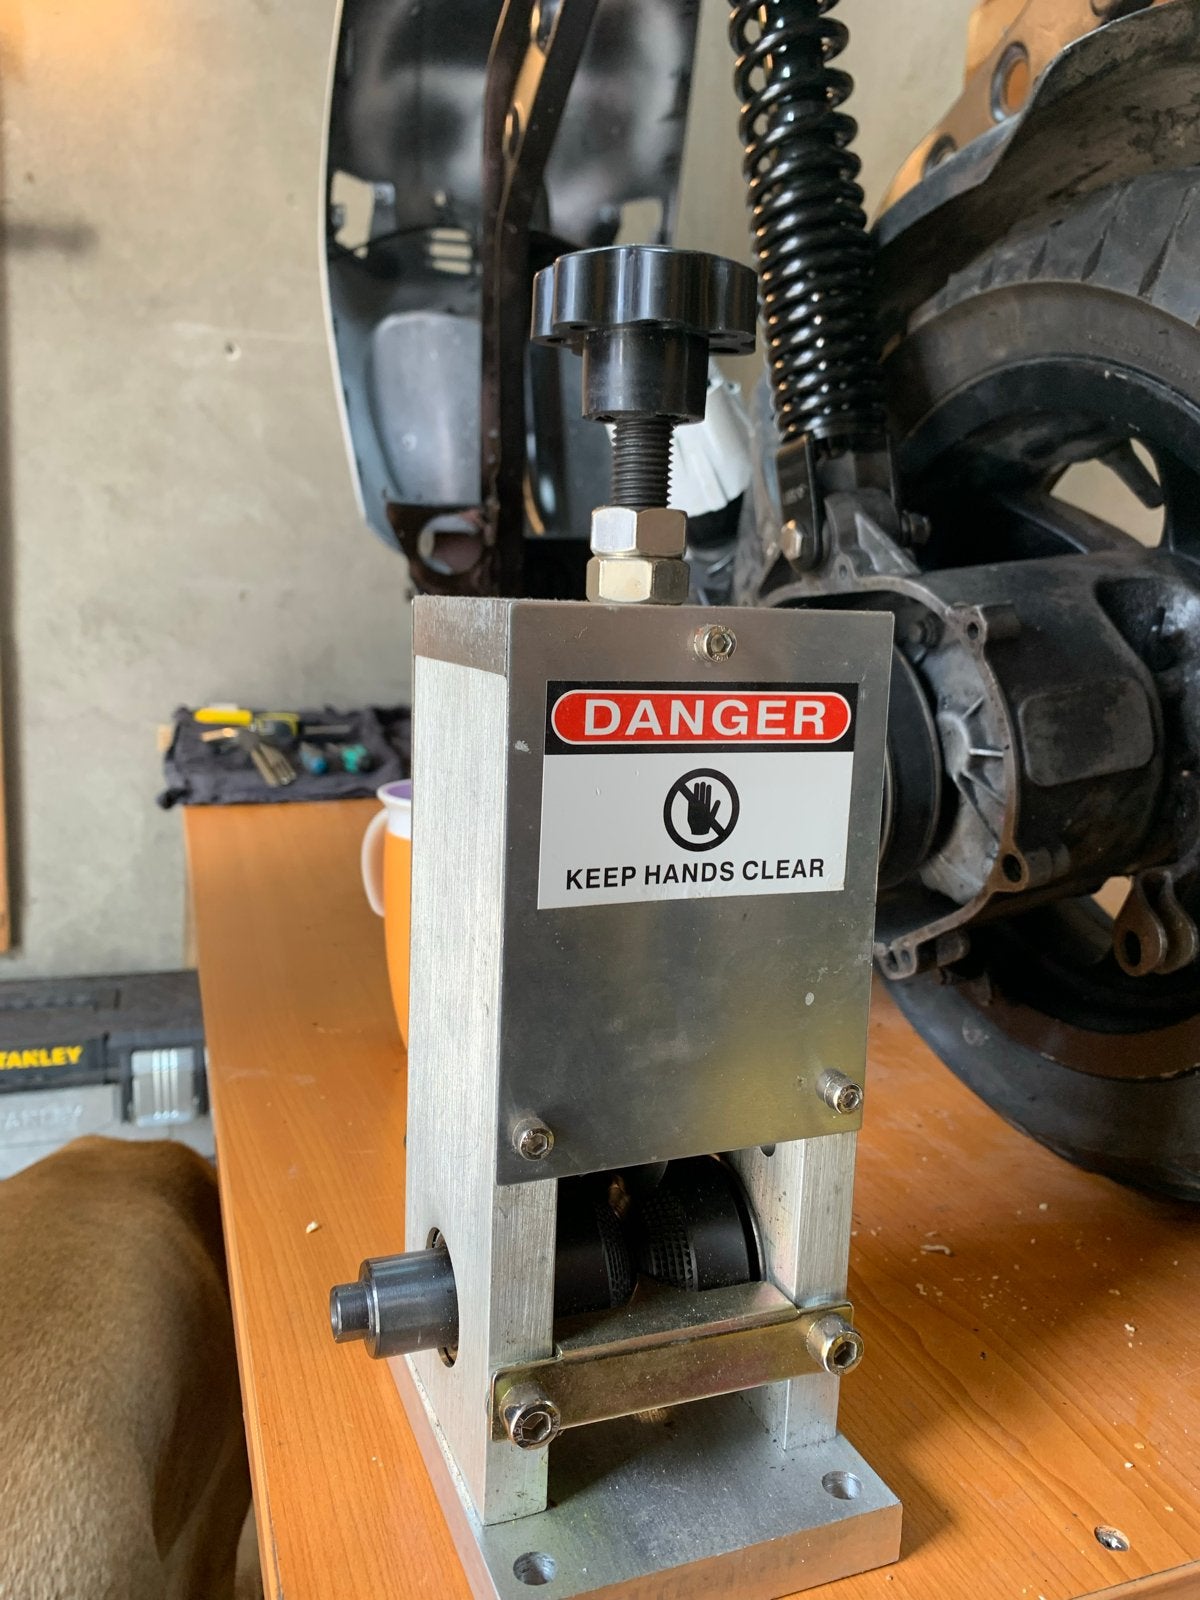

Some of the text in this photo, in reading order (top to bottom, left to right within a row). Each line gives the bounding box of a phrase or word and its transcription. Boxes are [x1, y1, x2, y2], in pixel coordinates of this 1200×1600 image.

[584, 699, 826, 736] DANGER
[566, 858, 824, 890] KEEP HANDS CLEAR
